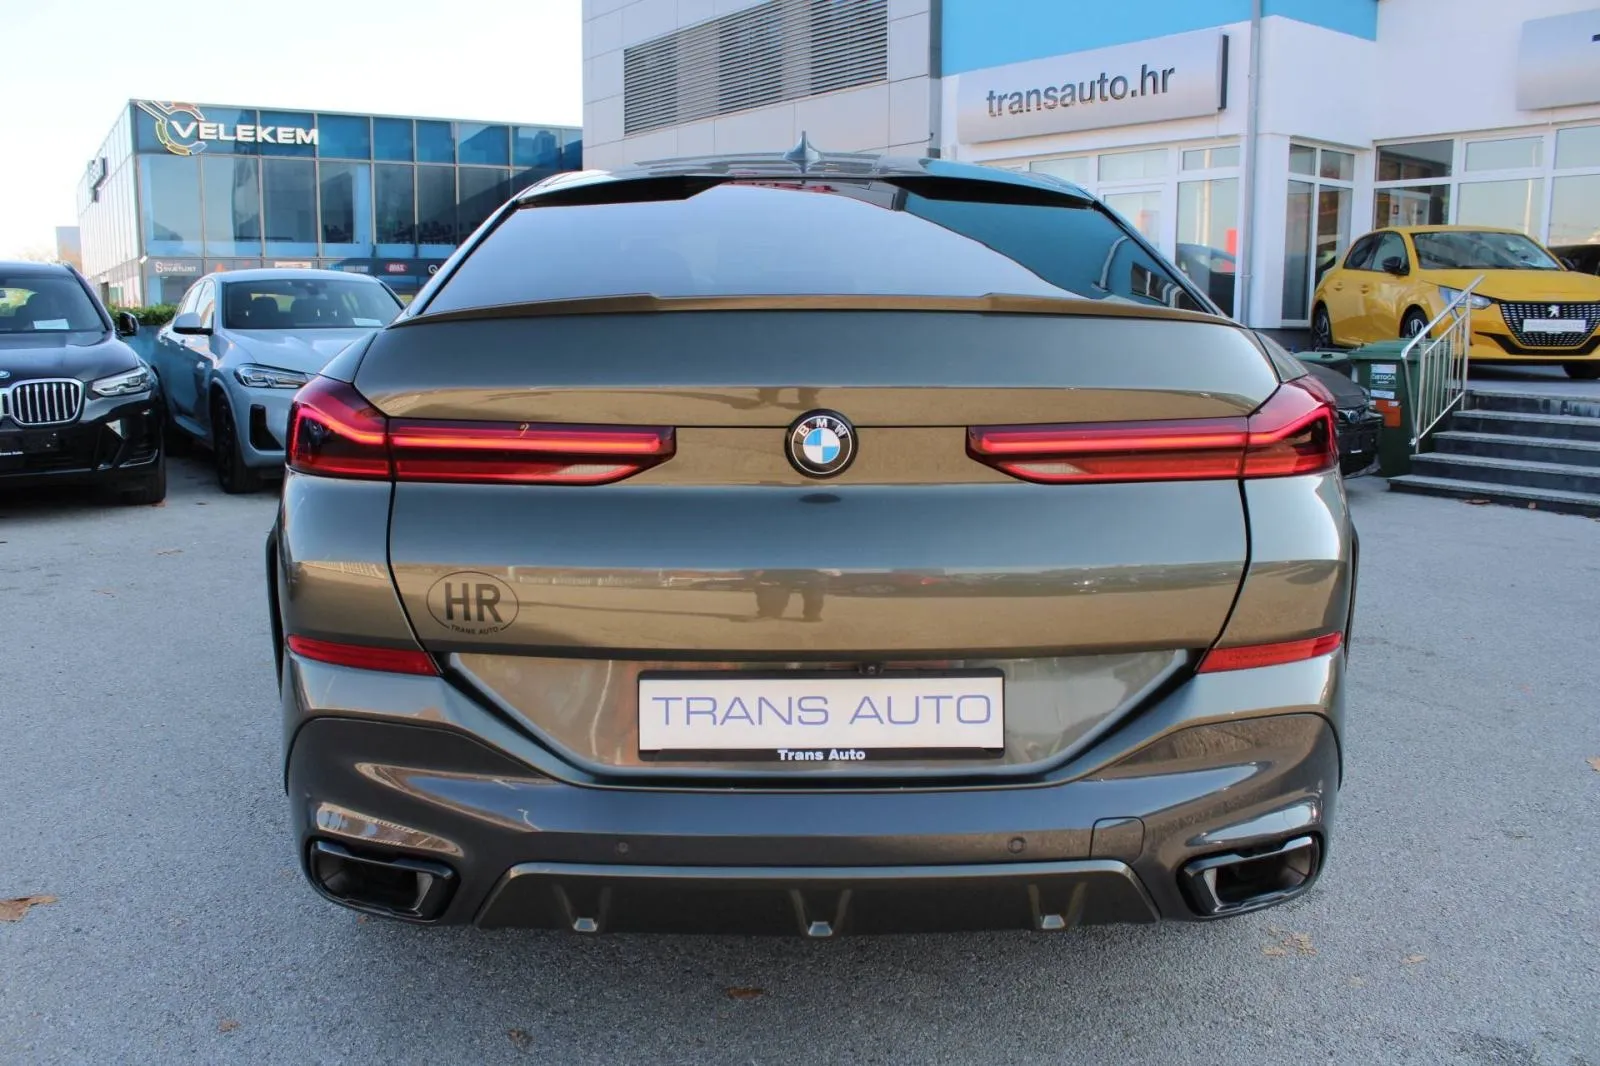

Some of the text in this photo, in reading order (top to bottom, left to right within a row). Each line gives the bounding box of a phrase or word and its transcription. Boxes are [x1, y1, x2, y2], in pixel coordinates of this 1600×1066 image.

[986, 63, 1175, 117] transauto.hr
[170, 120, 319, 145] VELEKEM
[797, 418, 847, 438] BMW
[444, 582, 503, 623] HR
[451, 624, 498, 635] TRANS AUTO
[652, 695, 992, 726] TRANS AUTO
[777, 748, 866, 761] Trans Auto
